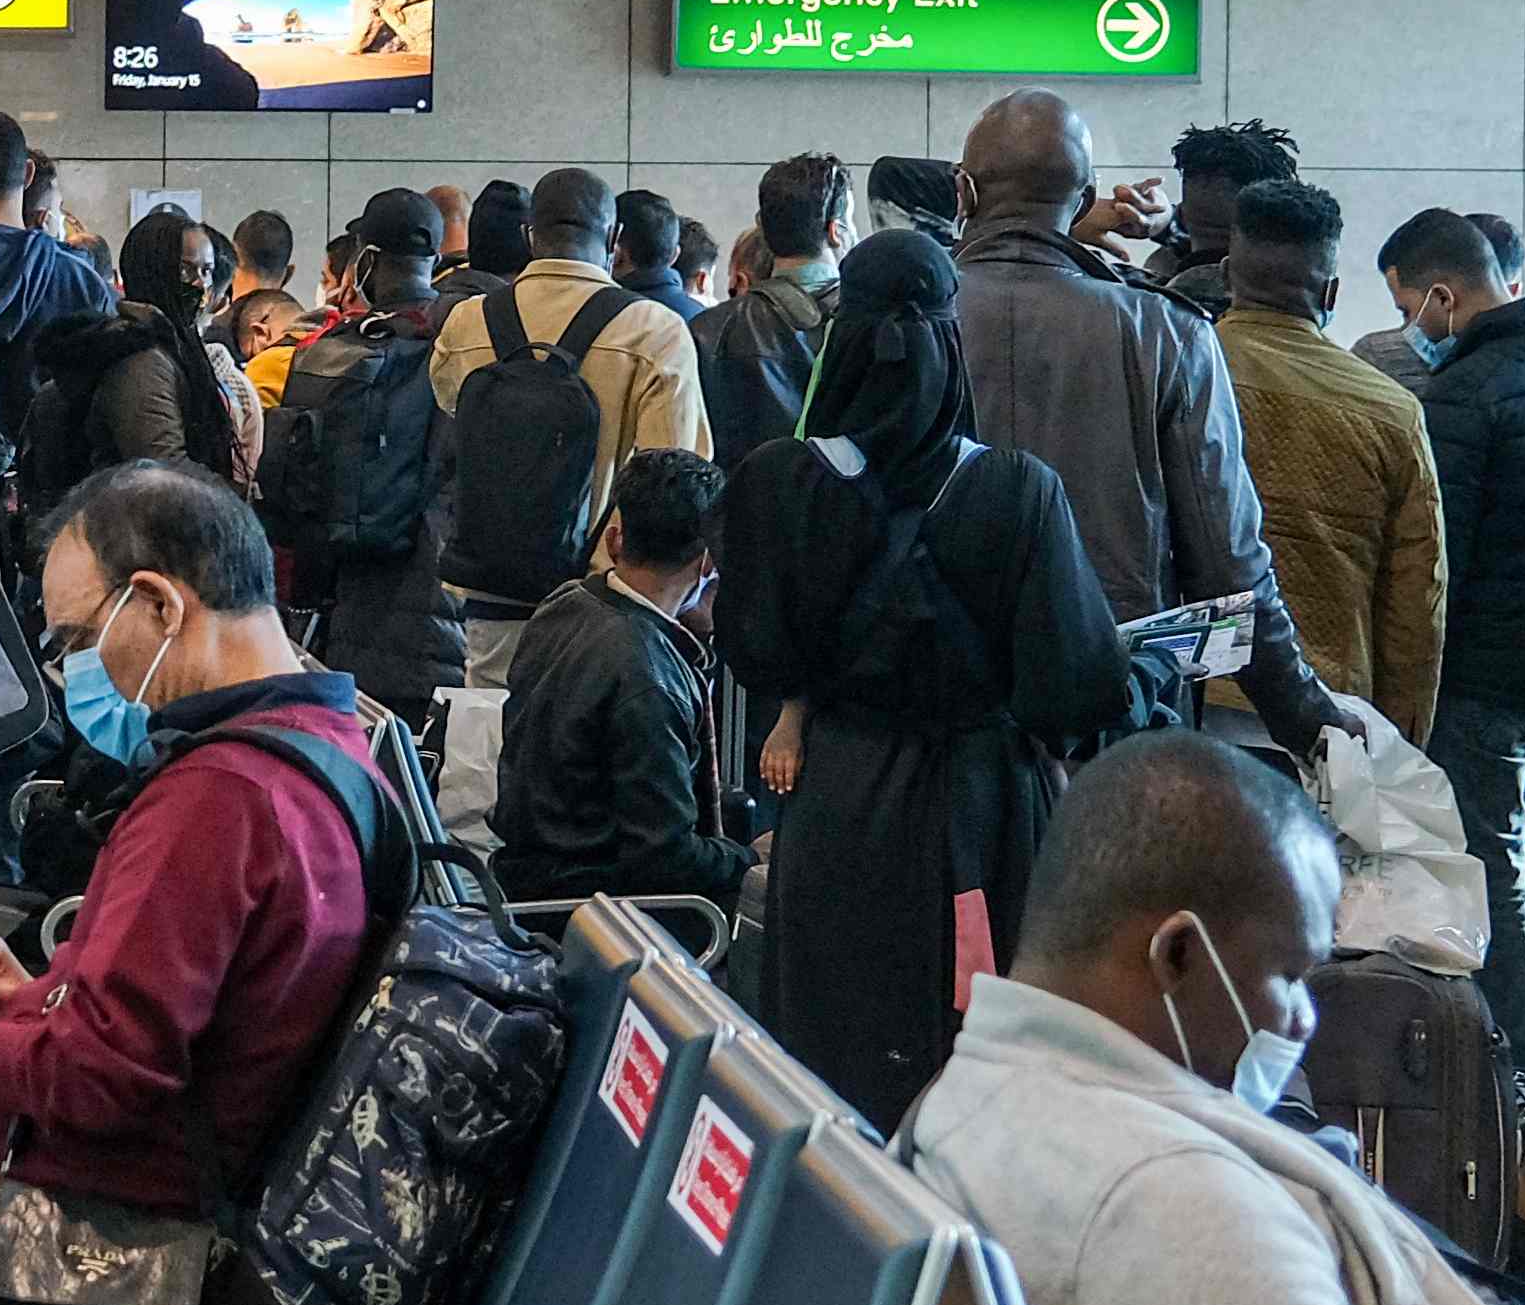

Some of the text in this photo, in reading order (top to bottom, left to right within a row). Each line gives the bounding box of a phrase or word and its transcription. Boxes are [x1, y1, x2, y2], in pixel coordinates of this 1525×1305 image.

[112, 45, 159, 69] 8:26
[708, 18, 914, 62] مخرج للطوارئ
